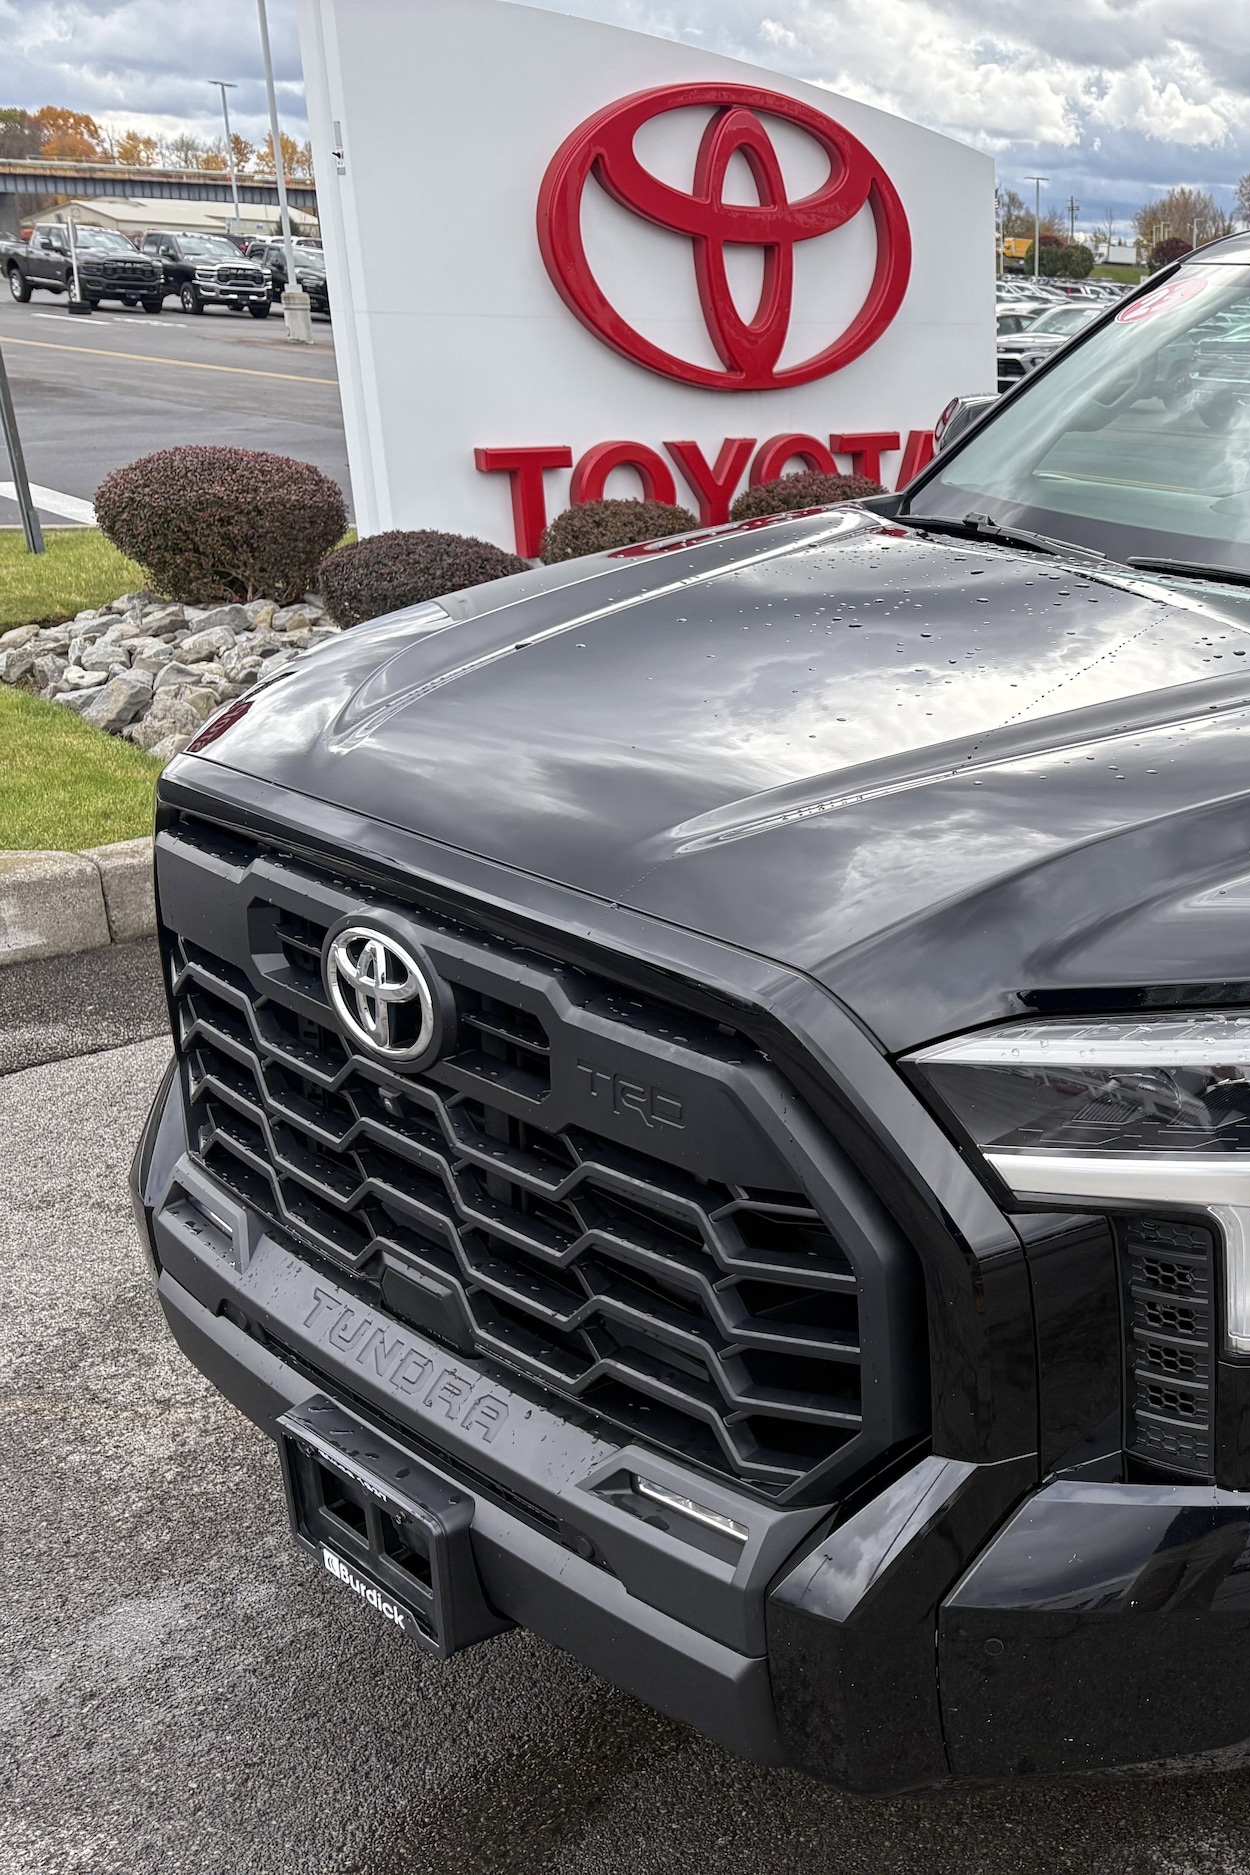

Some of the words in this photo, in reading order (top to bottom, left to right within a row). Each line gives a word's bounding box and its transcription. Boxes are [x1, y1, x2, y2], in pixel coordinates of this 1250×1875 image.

[576, 1058, 687, 1129] TRD
[303, 1287, 510, 1444] TUNDRA
[340, 1562, 405, 1630] Burdick
